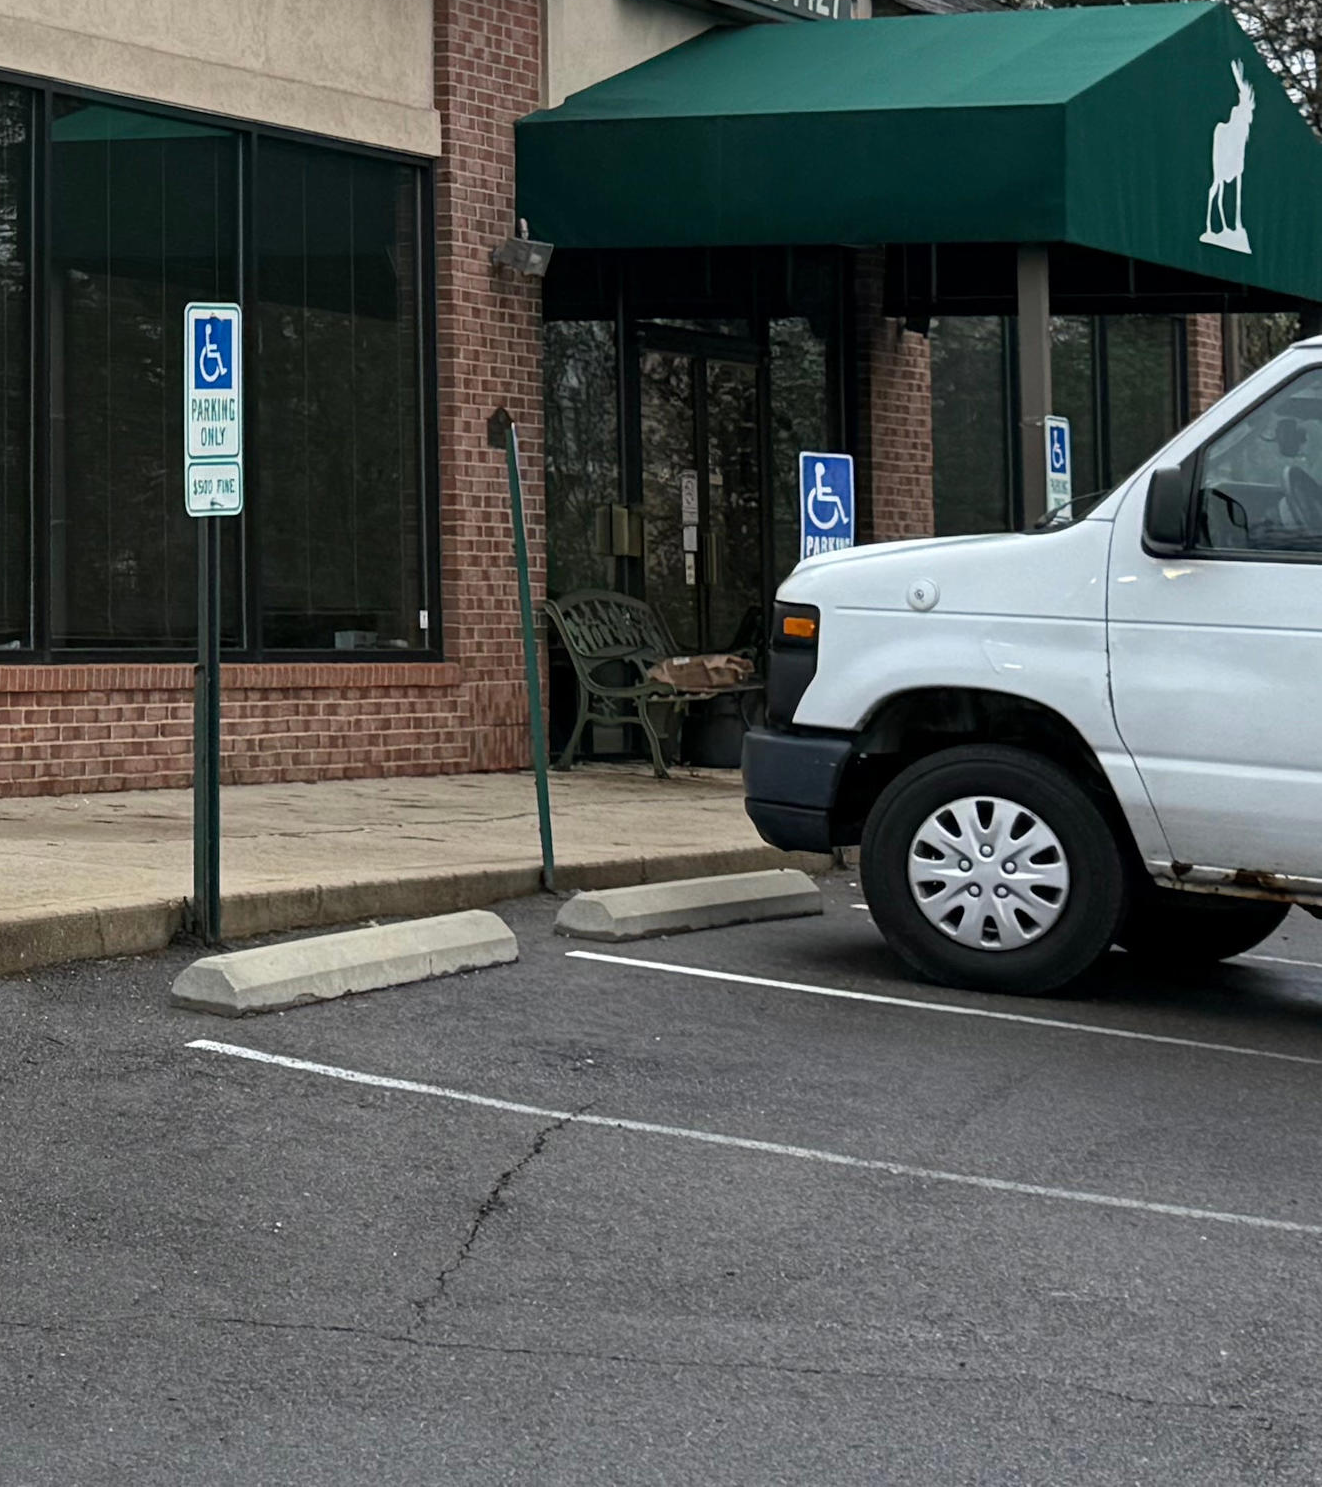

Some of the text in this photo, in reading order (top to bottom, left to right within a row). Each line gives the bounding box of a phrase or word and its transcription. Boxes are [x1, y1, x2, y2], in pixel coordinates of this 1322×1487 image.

[191, 398, 235, 421] PARKING
[200, 425, 226, 446] ONLY
[217, 478, 235, 494] FINE
